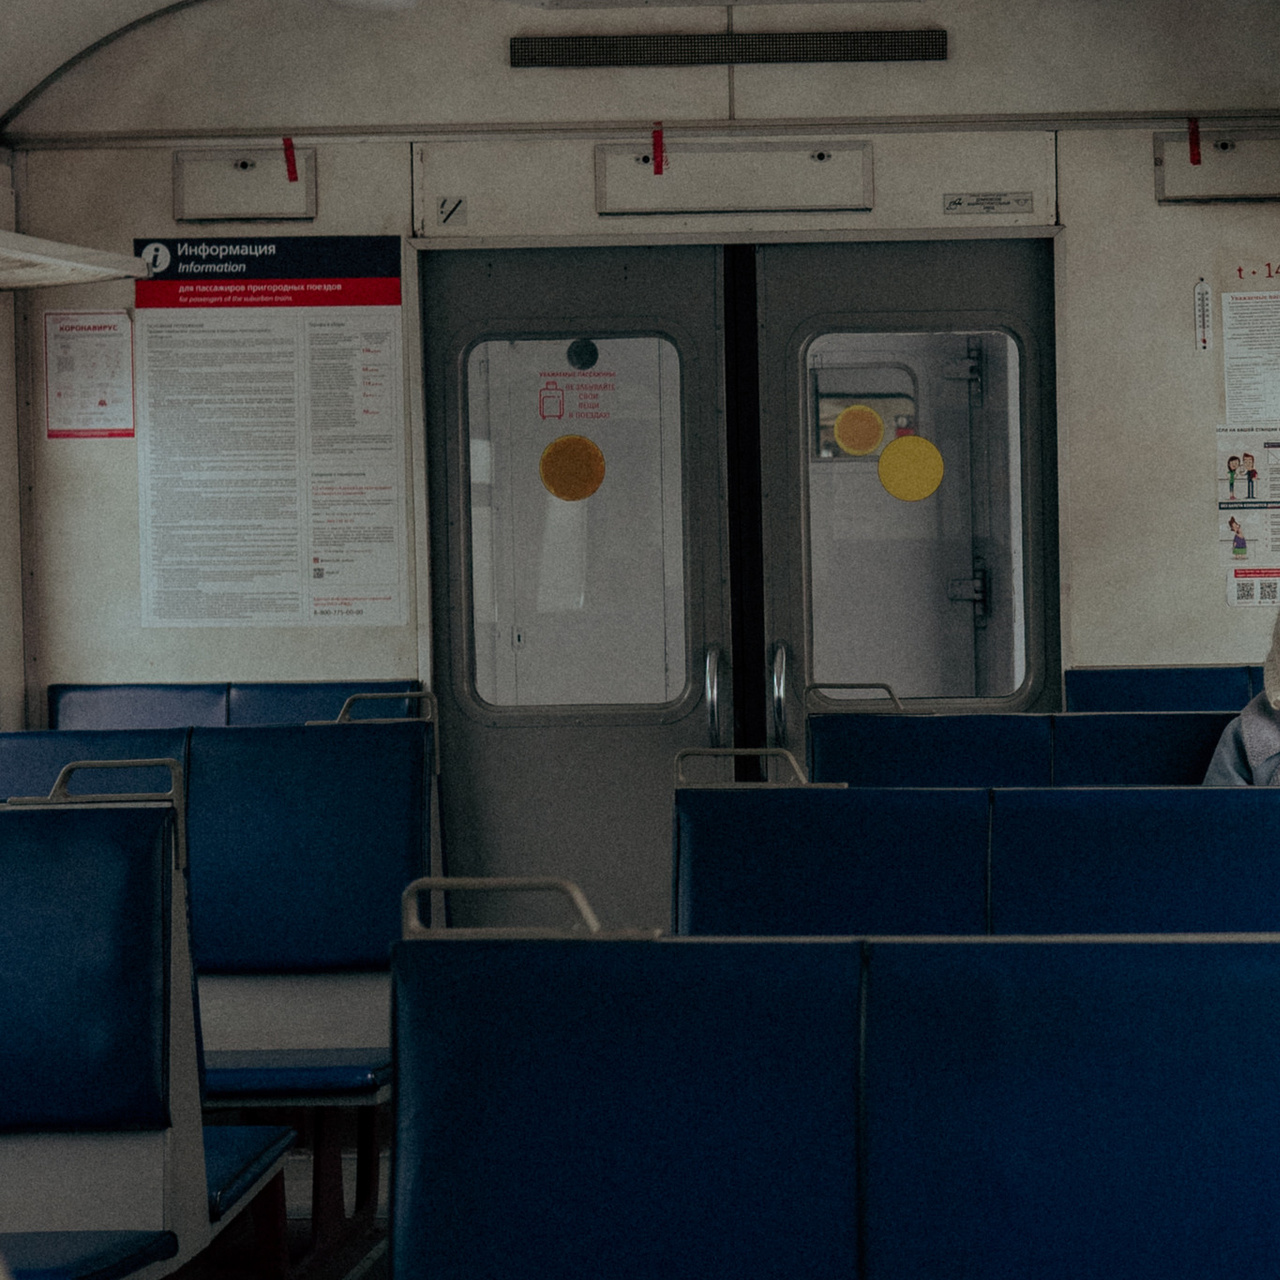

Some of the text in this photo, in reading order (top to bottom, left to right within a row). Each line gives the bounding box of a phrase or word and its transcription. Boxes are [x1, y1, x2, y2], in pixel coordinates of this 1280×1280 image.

[177, 243, 276, 259] Информация
[178, 261, 246, 274] Information
[1237, 265, 1244, 280] t
[178, 283, 342, 293] для пассажиров пригородных поездов
[189, 296, 223, 304] passengers
[59, 324, 118, 332] КОРОНАВИРУС
